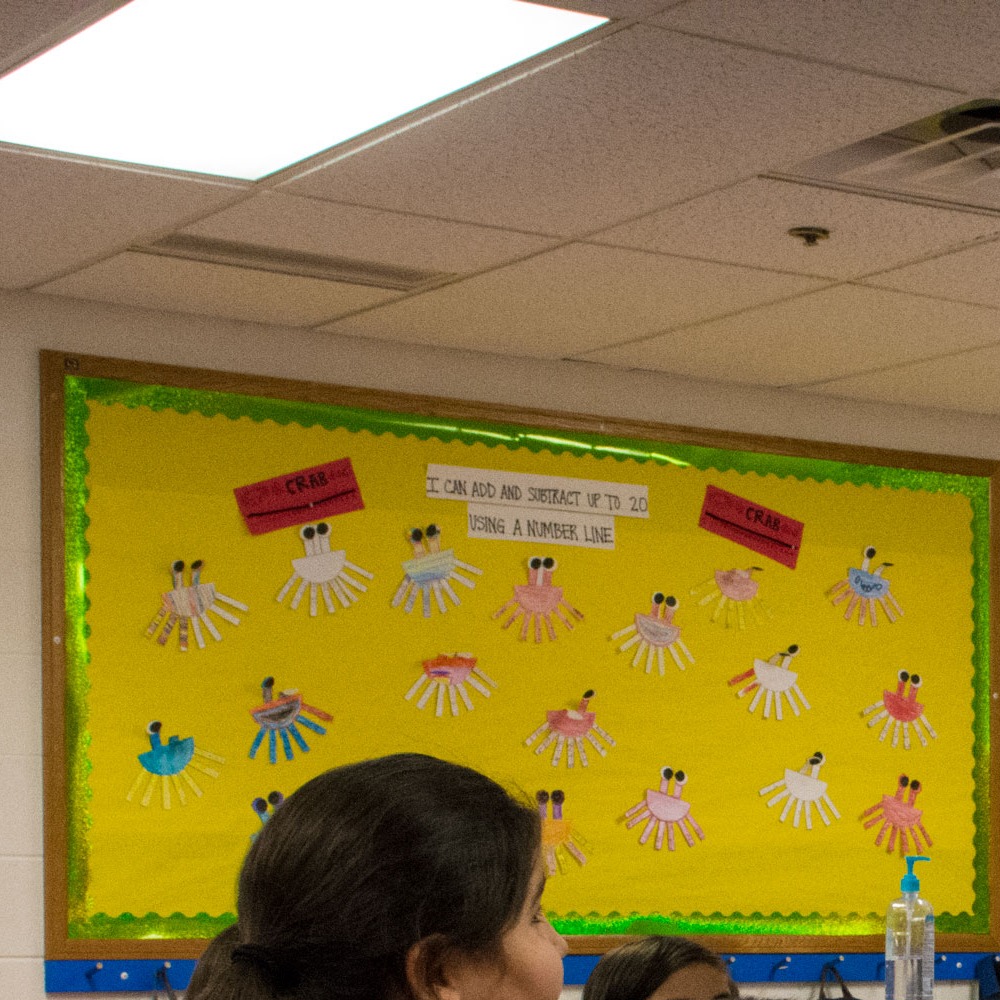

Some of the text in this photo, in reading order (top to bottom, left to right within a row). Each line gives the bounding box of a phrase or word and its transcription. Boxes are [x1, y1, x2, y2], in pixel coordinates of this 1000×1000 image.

[285, 471, 330, 495] CRAB
[426, 477, 648, 513] I CAN ADD AND SUBTRACT UP TO 20
[468, 514, 614, 544] USING A NUMBER LINE
[745, 506, 781, 532] CRAB
